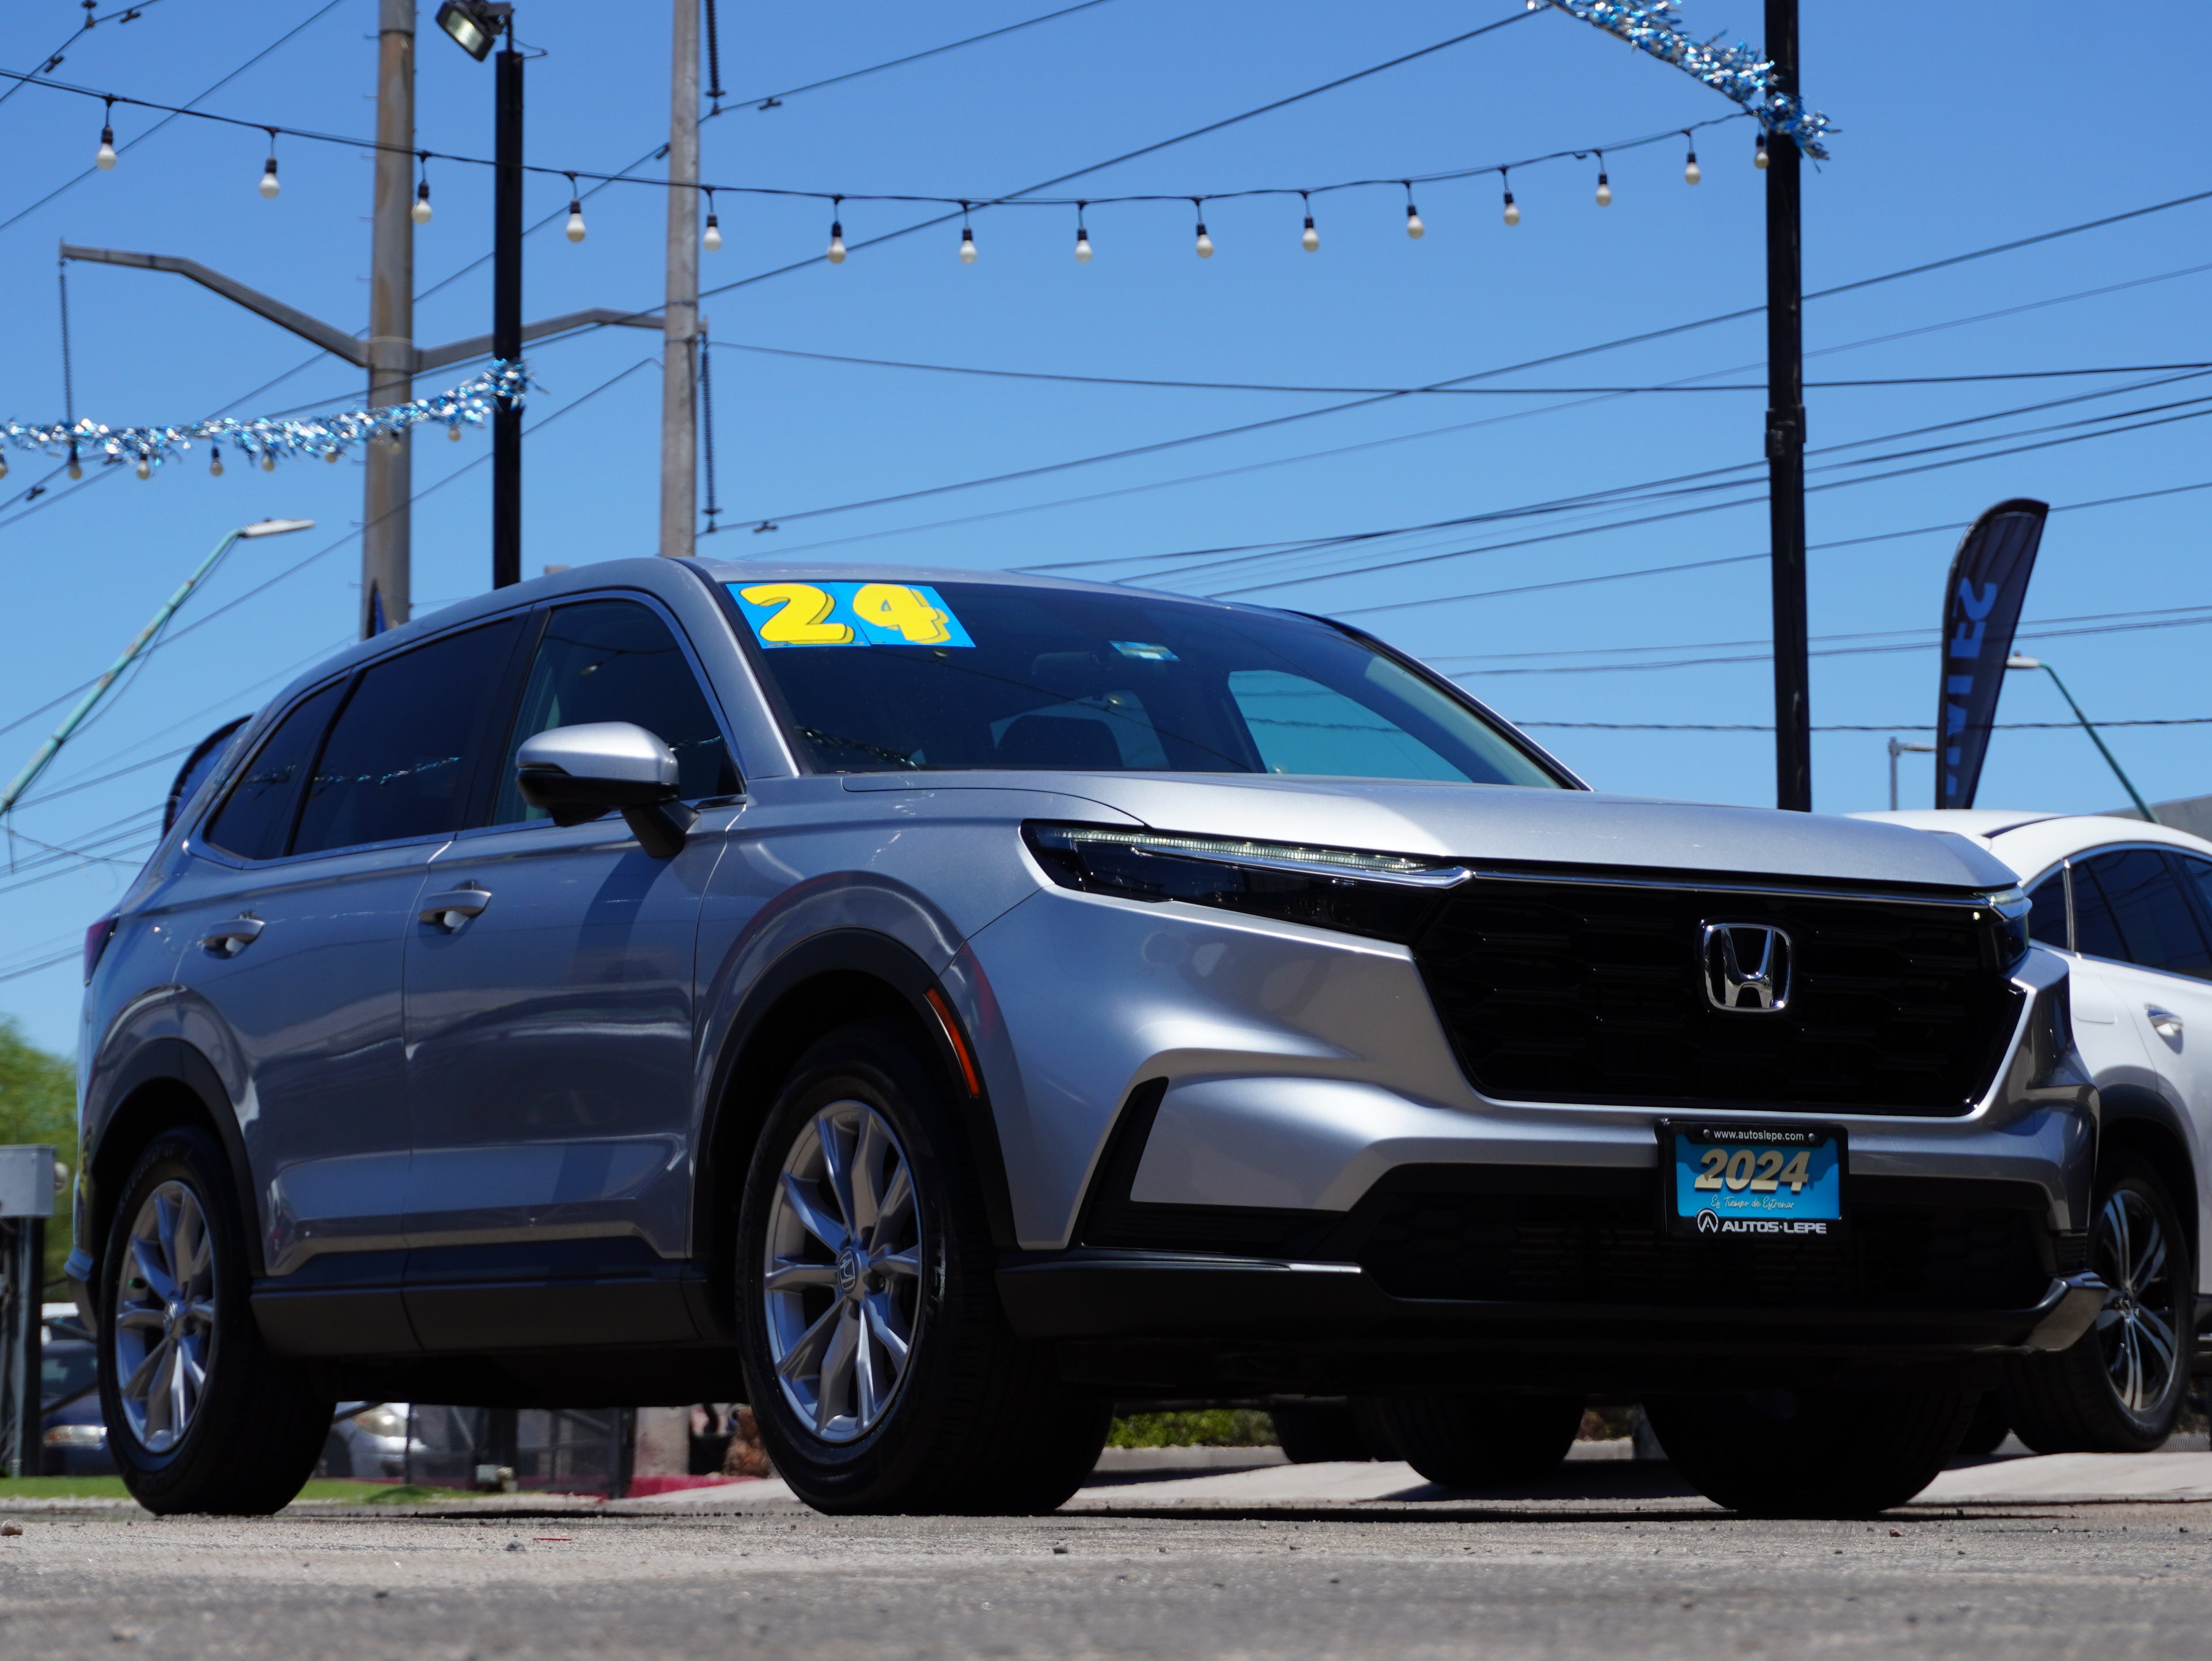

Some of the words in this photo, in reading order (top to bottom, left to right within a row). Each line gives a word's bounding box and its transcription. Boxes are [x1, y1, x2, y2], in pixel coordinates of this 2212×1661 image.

[739, 583, 951, 644] 24
[1714, 1130, 1804, 1141] www.autoslepe.com
[1694, 1148, 1810, 1193] 2024
[1710, 1194, 1721, 1209] Es
[1724, 1196, 1749, 1209] Tiempo
[1751, 1198, 1761, 1208] de
[1763, 1196, 1795, 1210] Estrenar
